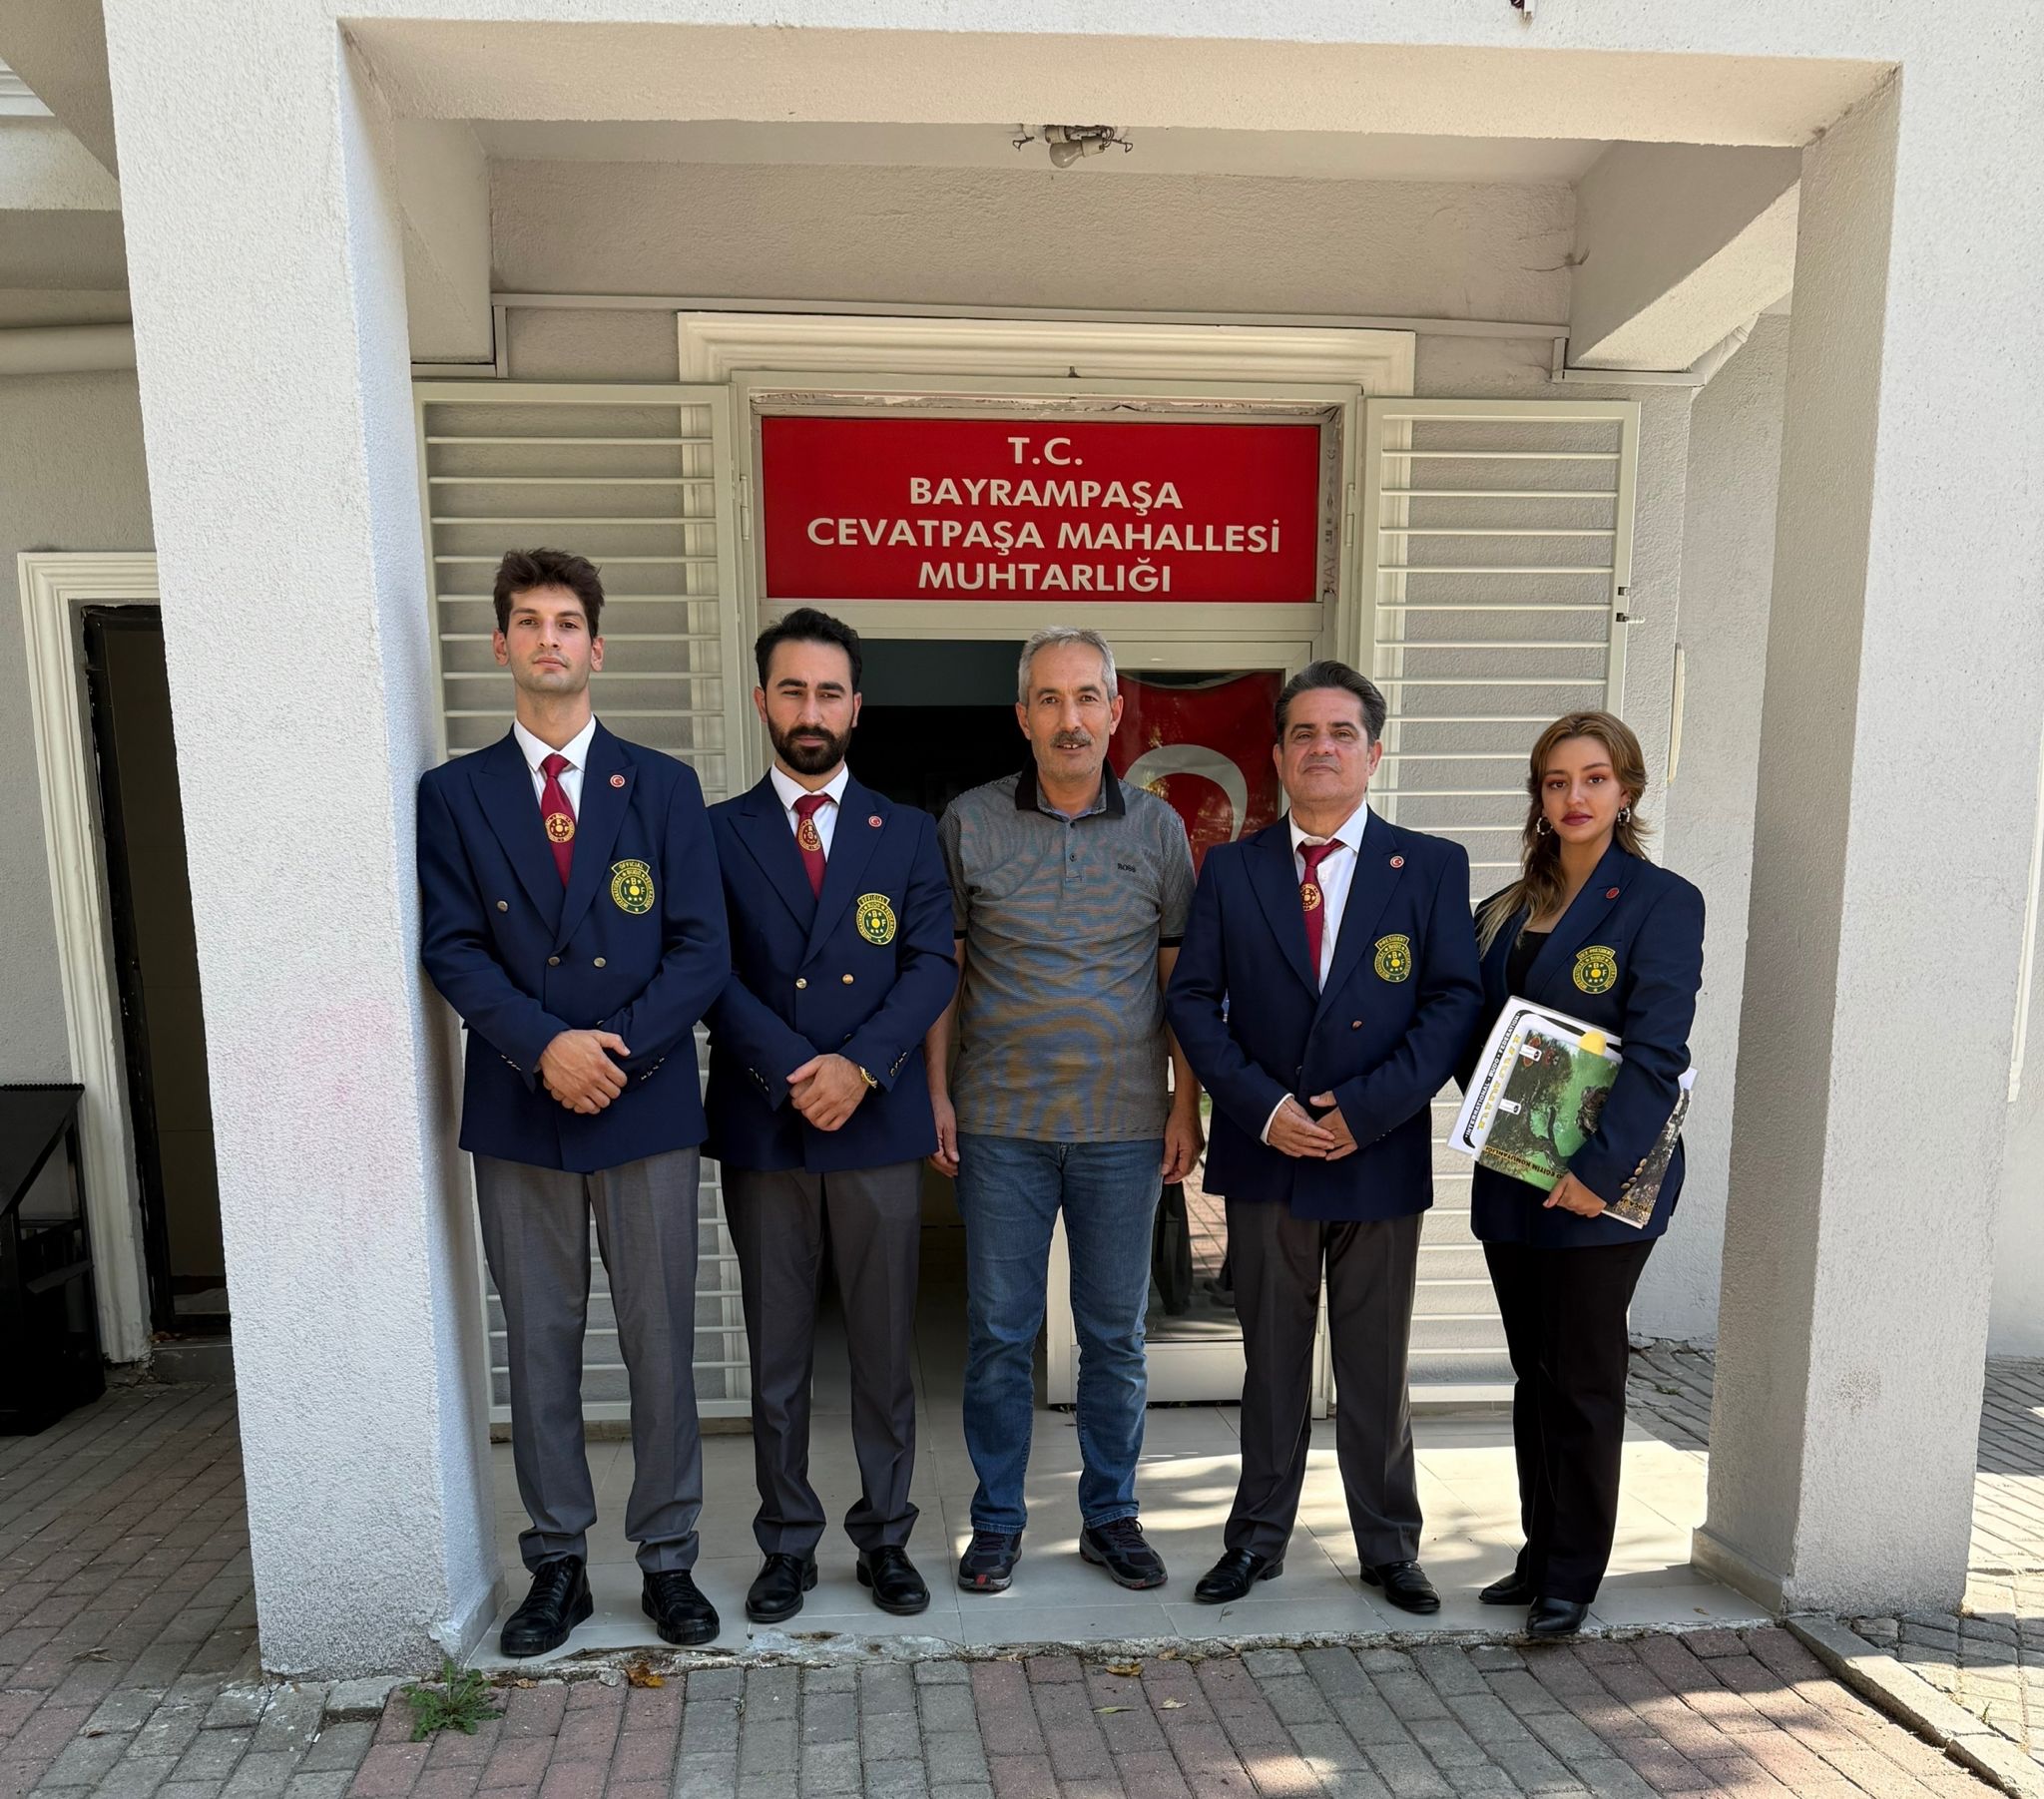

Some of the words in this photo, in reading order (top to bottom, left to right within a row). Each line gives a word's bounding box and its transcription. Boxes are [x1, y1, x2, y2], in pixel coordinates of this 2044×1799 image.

[1007, 436, 1084, 466] T.C.
[909, 478, 1185, 517] BAYRAMPAŞA
[807, 517, 1045, 556] CEVATPAŞA
[1057, 520, 1280, 554] MAHALLESİ
[917, 557, 1172, 594] MUHTARLIĞI
[1466, 1082, 1490, 1135] INTERNATIONAL
[1500, 1016, 1520, 1056] FEDERATION
